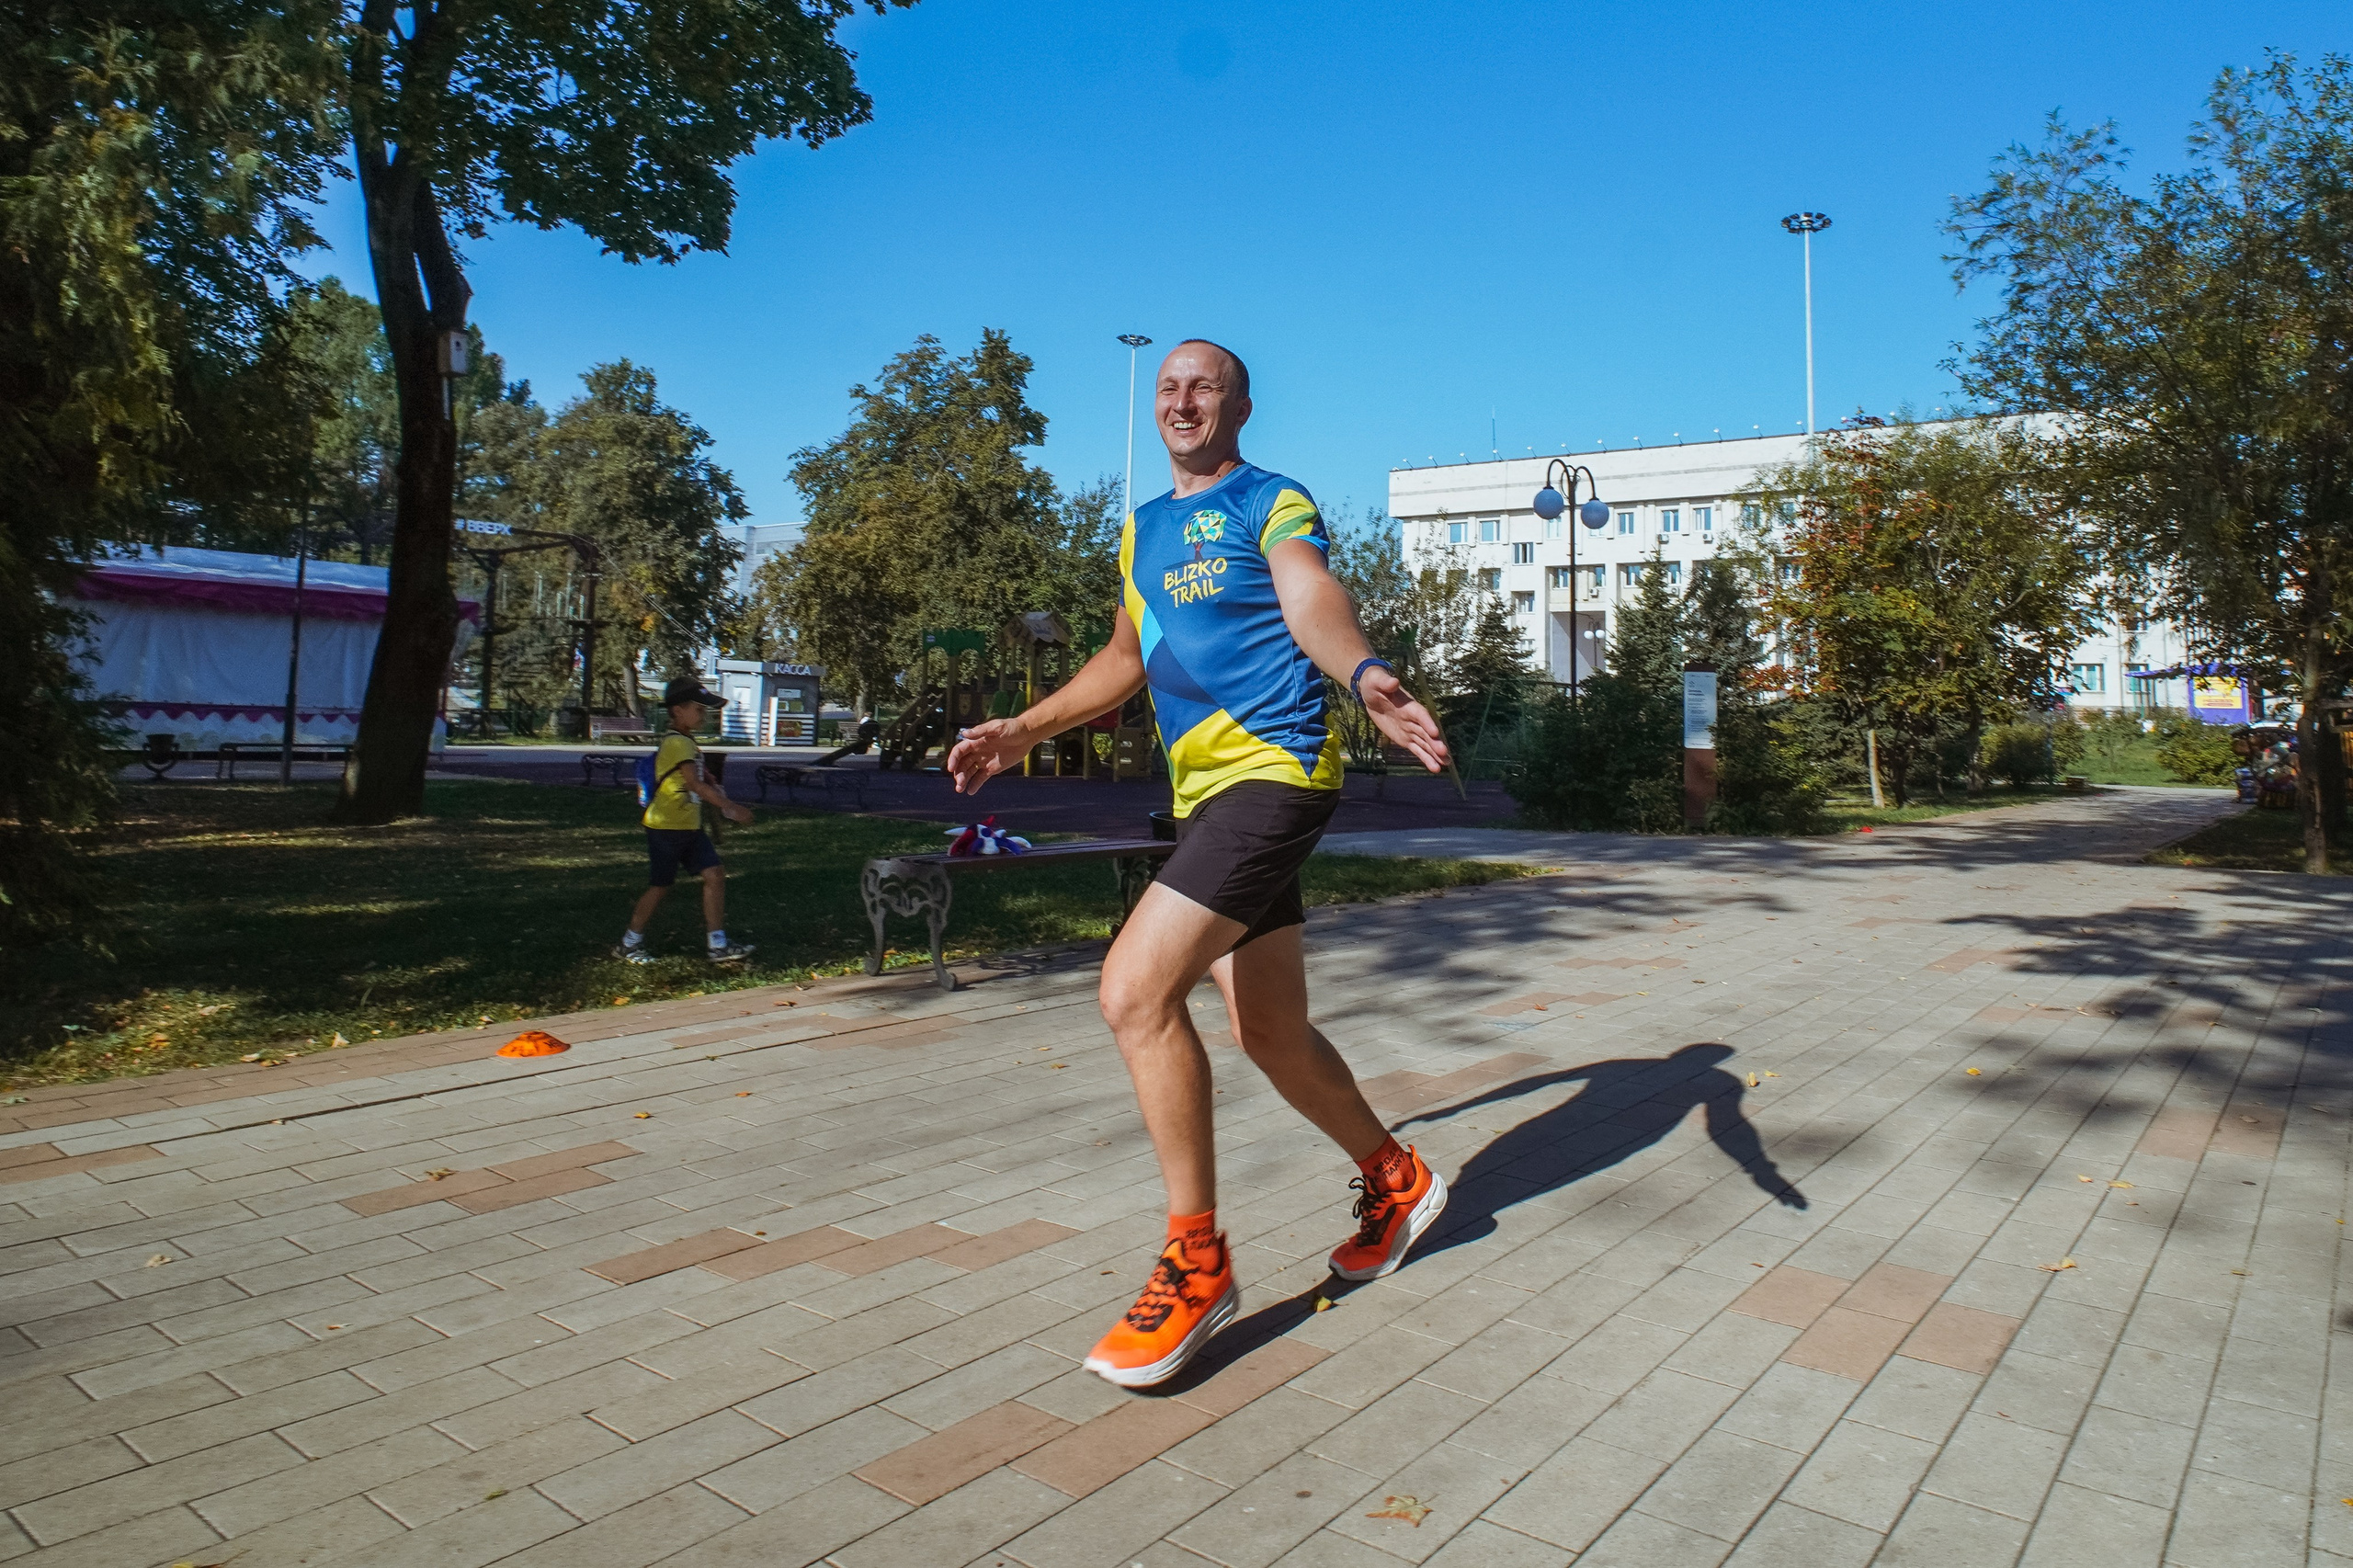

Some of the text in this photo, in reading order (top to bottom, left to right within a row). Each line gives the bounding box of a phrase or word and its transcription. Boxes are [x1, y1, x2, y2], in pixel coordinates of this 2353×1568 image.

[1164, 557, 1228, 591] BLIZKO
[1170, 578, 1225, 608] TRAIL
[774, 663, 810, 676] КАССА
